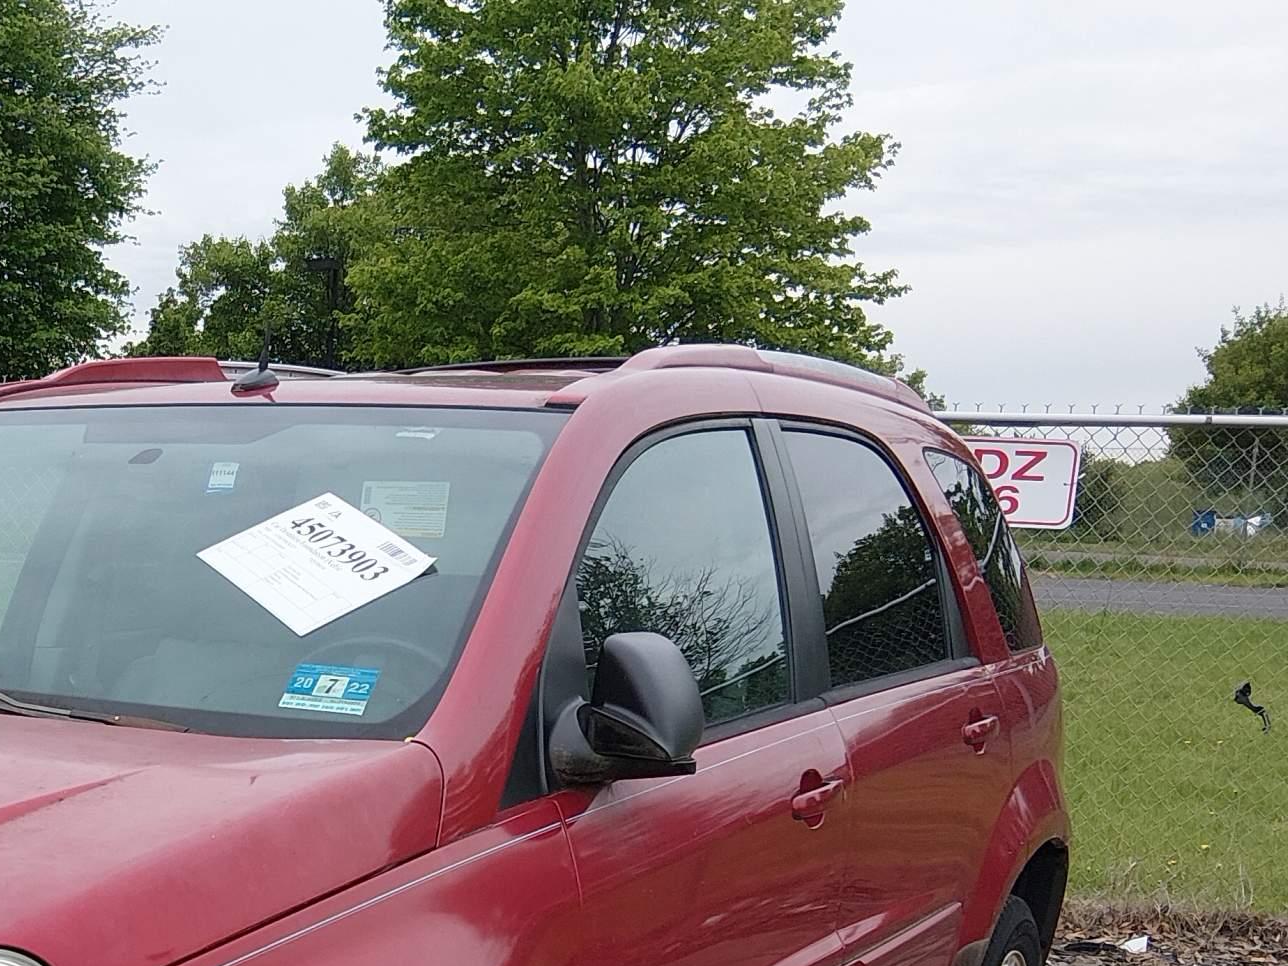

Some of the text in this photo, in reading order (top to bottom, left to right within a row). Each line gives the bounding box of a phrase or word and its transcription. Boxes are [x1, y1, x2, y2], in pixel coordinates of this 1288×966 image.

[974, 448, 1048, 482] DZ
[994, 485, 1020, 515] 6
[290, 517, 390, 581] 45073903
[293, 677, 370, 694] 20 7 22
